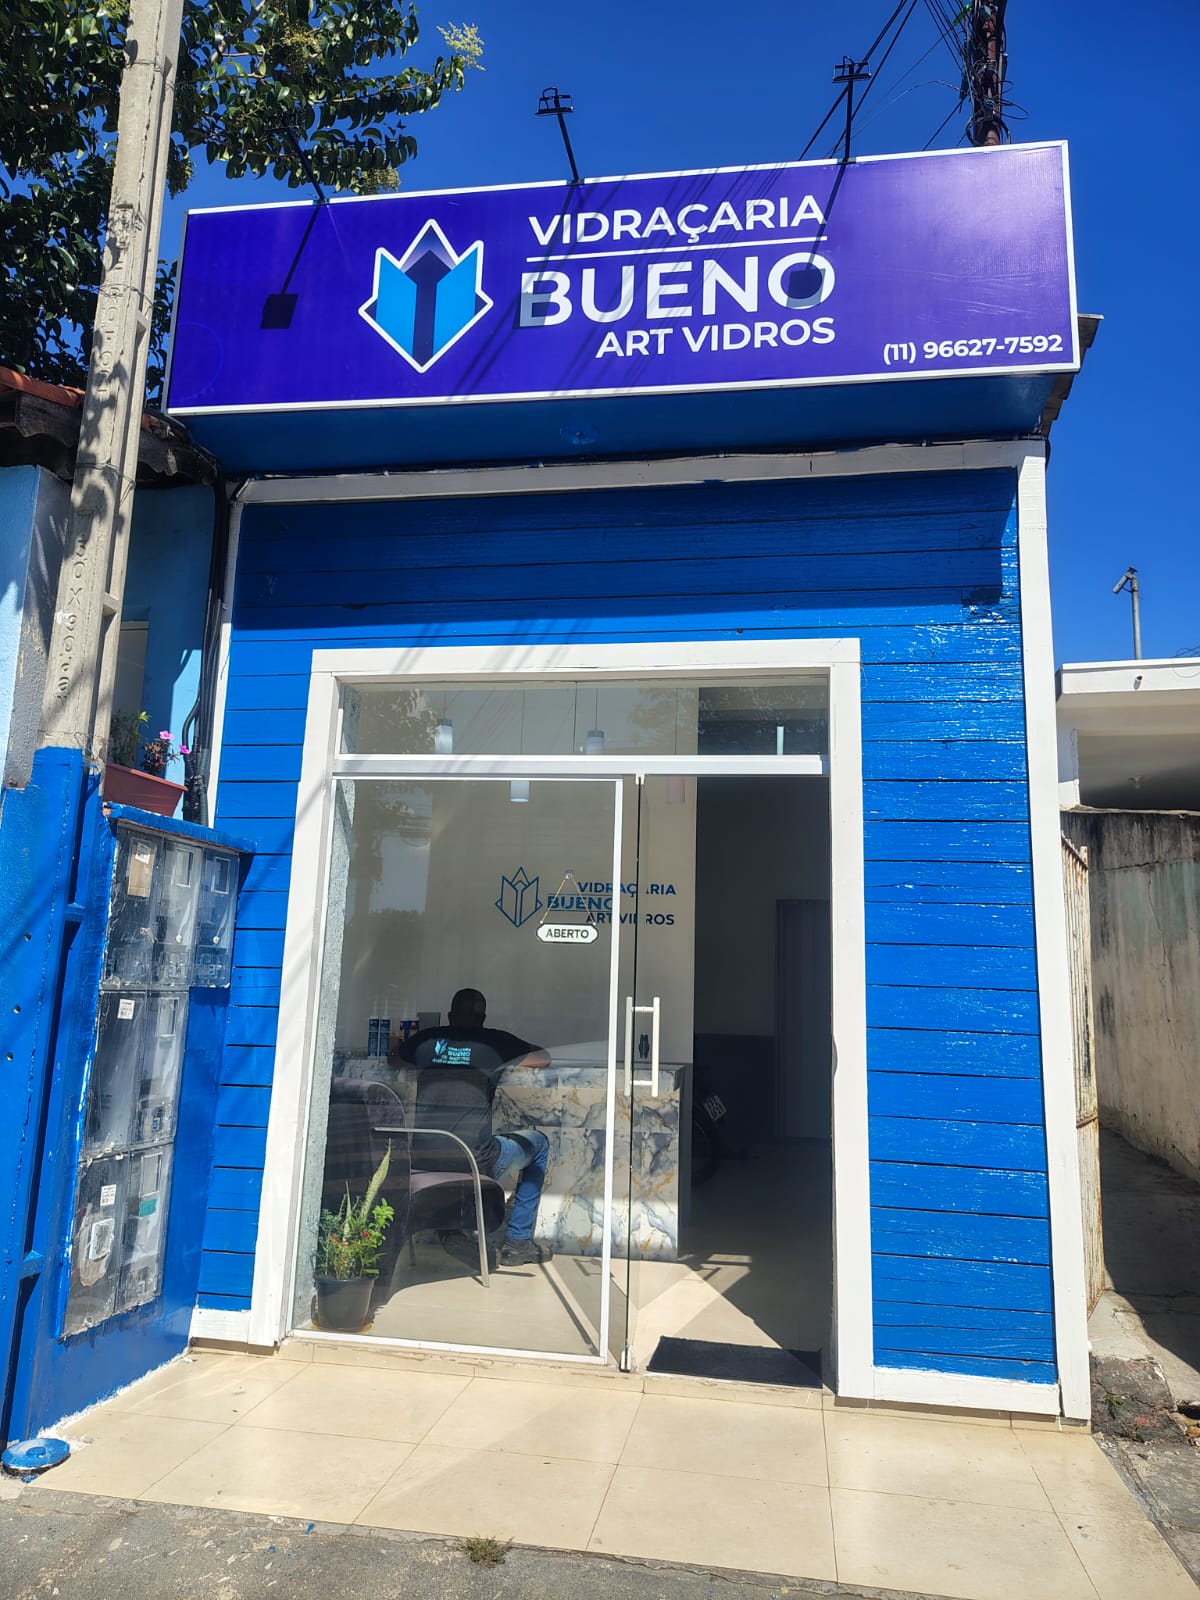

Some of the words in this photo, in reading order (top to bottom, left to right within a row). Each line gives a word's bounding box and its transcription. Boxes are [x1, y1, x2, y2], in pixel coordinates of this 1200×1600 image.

[529, 195, 827, 243] VIDRAÇARIA
[519, 252, 836, 327] BUENO
[595, 328, 673, 358] ART
[682, 317, 836, 352] VIDROS
[883, 341, 917, 365] (11)
[923, 334, 1063, 360] 96627-7592
[577, 882, 677, 897] VIDRAÇRIA
[545, 929, 590, 939] ABERTO
